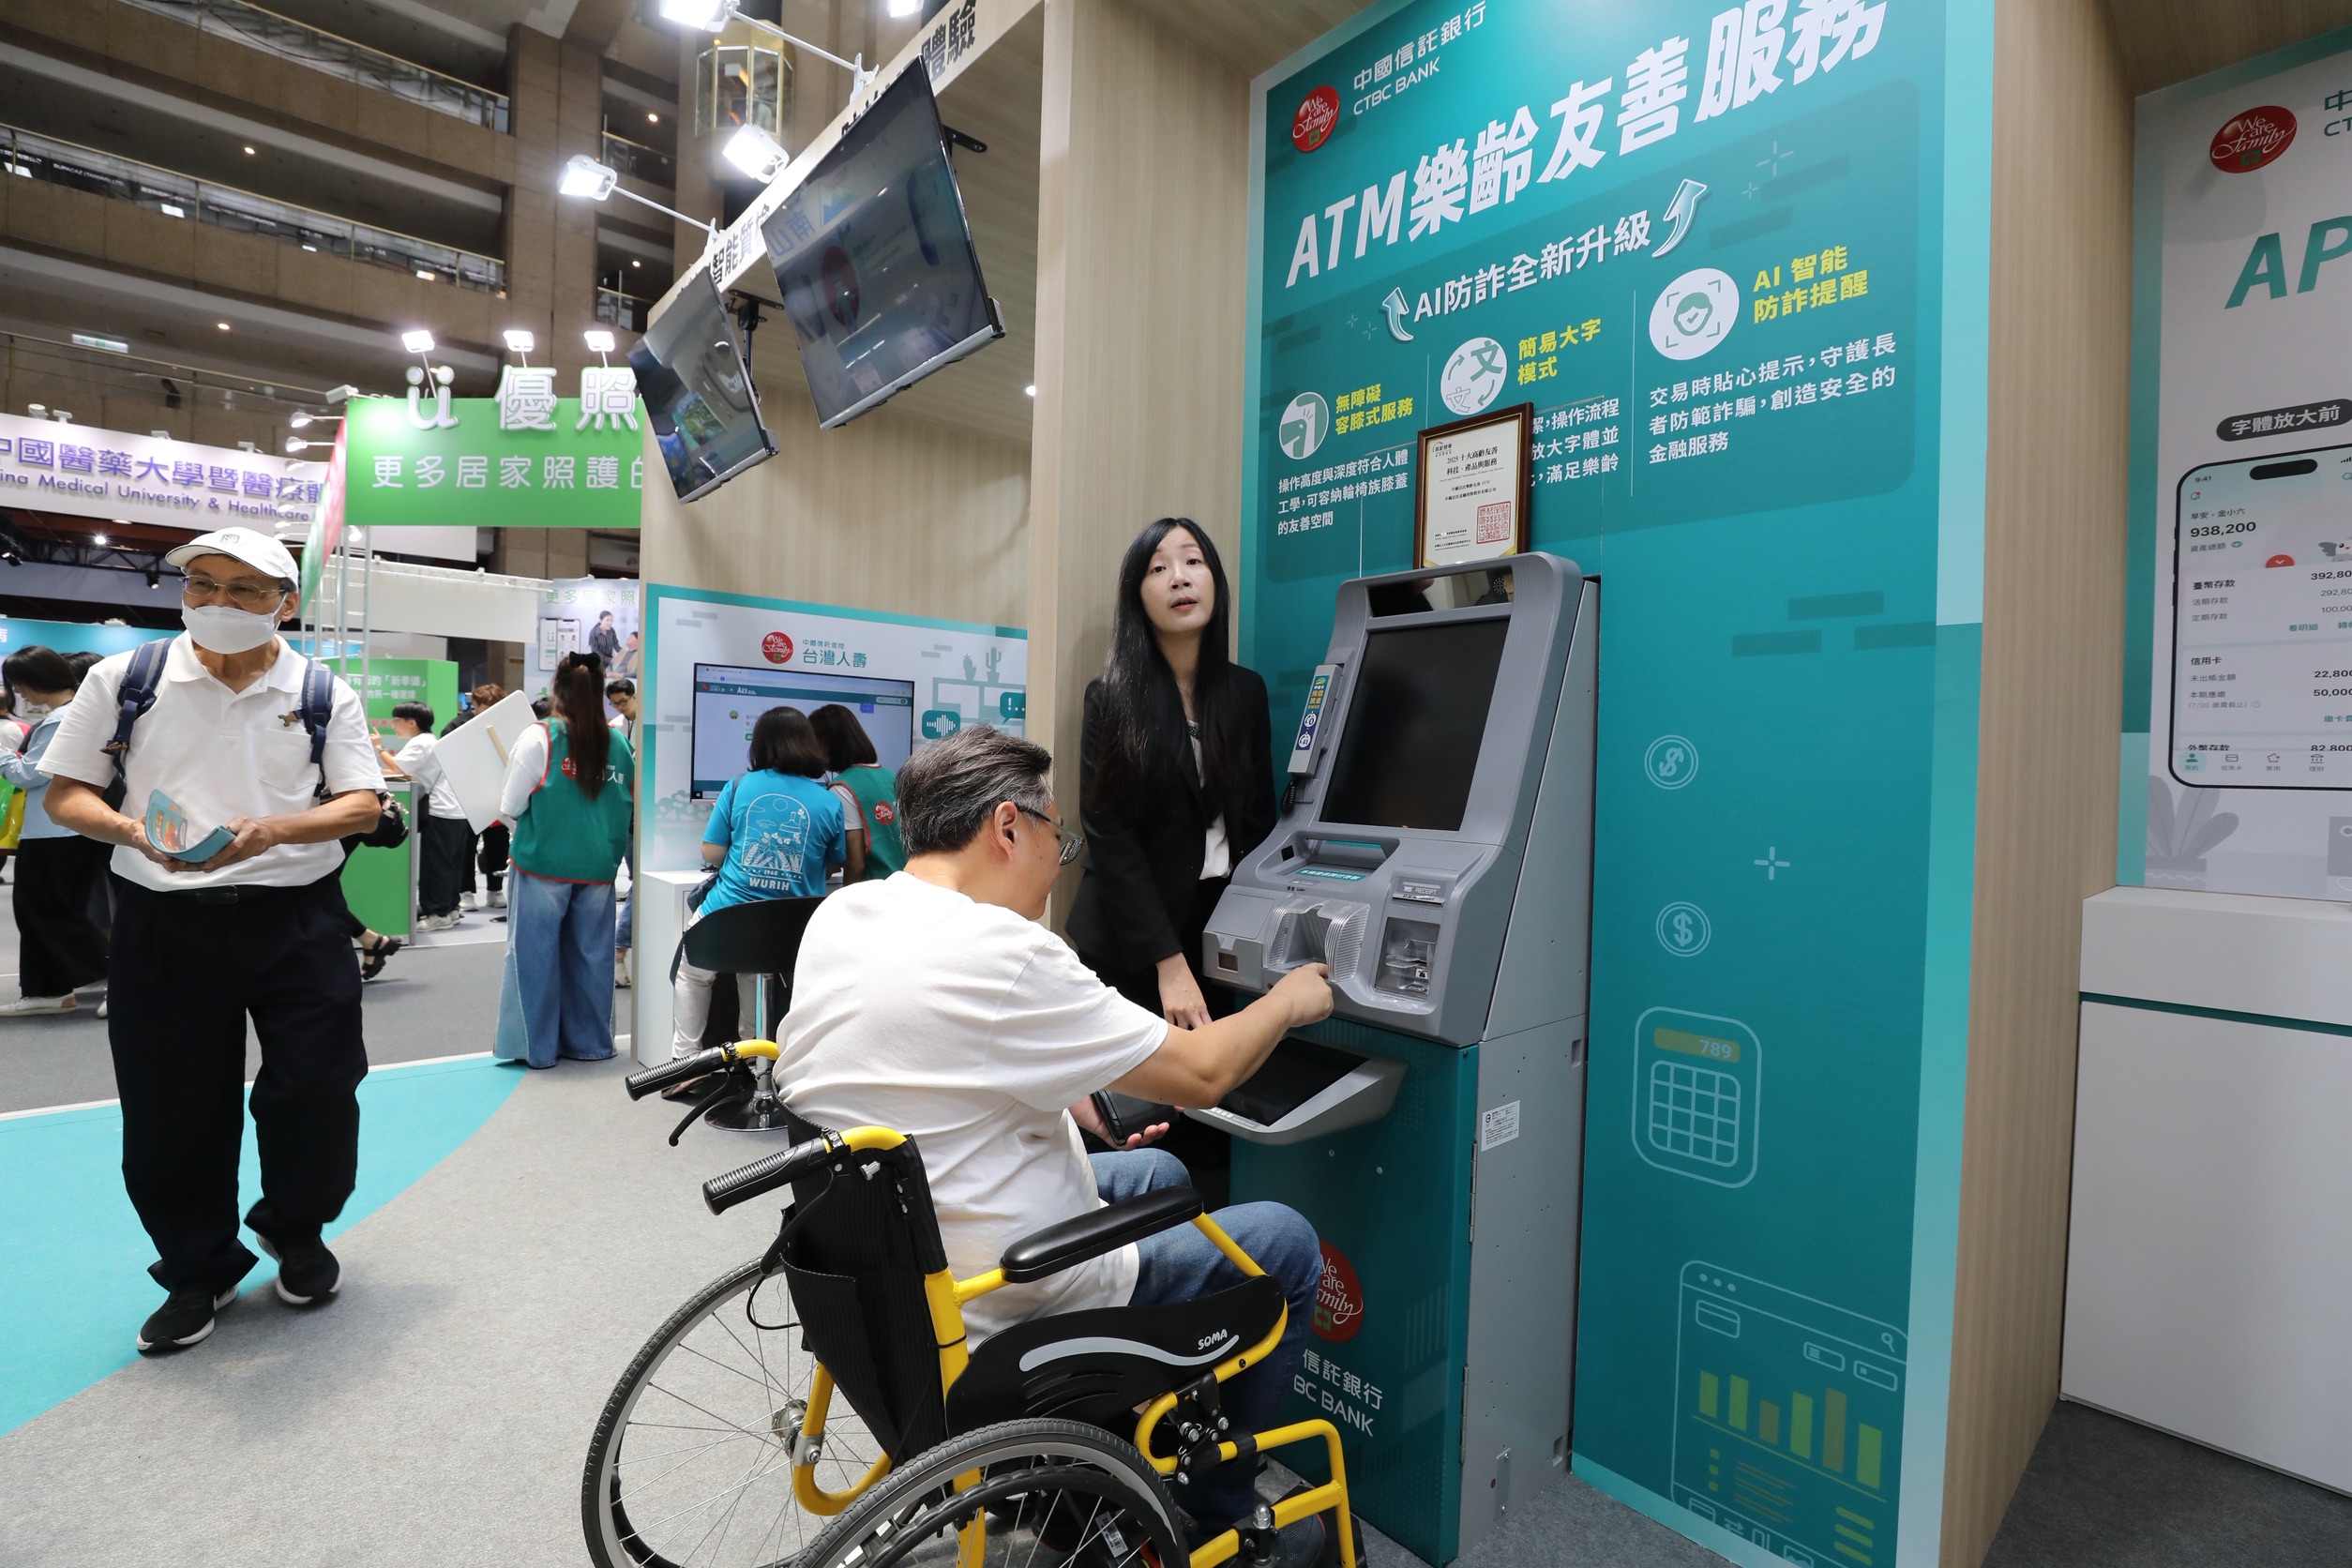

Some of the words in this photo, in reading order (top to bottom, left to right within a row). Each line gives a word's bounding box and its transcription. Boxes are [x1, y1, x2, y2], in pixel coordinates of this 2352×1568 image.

[1353, 0, 1486, 91] 中國信託銀行
[1353, 83, 1392, 115] CTBC
[1395, 57, 1440, 94] BANK
[2237, 116, 2266, 132] We
[2250, 123, 2274, 138] are
[1285, 0, 1887, 290] ATM樂齡友善服務
[1413, 211, 1651, 323] AI防詐全新升級
[1753, 267, 1781, 293] AI
[1790, 246, 1848, 283] 智能
[1754, 269, 1868, 324] 防詐提醒
[1518, 318, 1602, 360] 簡易大字
[1517, 355, 1558, 385] 模式
[1650, 332, 1896, 408] 交易時貼心提示，守護長
[1335, 384, 1381, 415] 無障礙
[1650, 366, 1896, 436] 者防範詐騙，創造安全的
[1335, 398, 1413, 436] 容膝式服務
[2231, 404, 2341, 436] 字體放大前
[1649, 431, 1729, 464] 金融服務
[1278, 448, 1409, 493] 操作高度與深度符合人體
[1530, 453, 1619, 487] ，滿足樂齡
[38, 474, 109, 495] Medical
[118, 486, 201, 509] University
[208, 497, 220, 509] &
[1277, 511, 1334, 535] 的友善空間
[2190, 521, 2256, 538] 938,200
[2191, 542, 2226, 552] 資產總額
[2193, 596, 2228, 606] 活期存款
[2194, 580, 2236, 591] 臺幣存款
[2192, 613, 2228, 622] 定期存款
[2289, 624, 2318, 632] 看明細
[803, 648, 867, 668] 台灣人壽
[2191, 656, 2222, 666] 信用卡
[749, 877, 790, 891] WURIH
[1415, 886, 1438, 895] RECEIPT
[1699, 1039, 1732, 1059] 789
[1322, 1274, 1345, 1295] are
[1198, 1328, 1228, 1350] SOMA
[1303, 1349, 1382, 1410] 信託銀行
[1321, 1390, 1374, 1438] BANK
